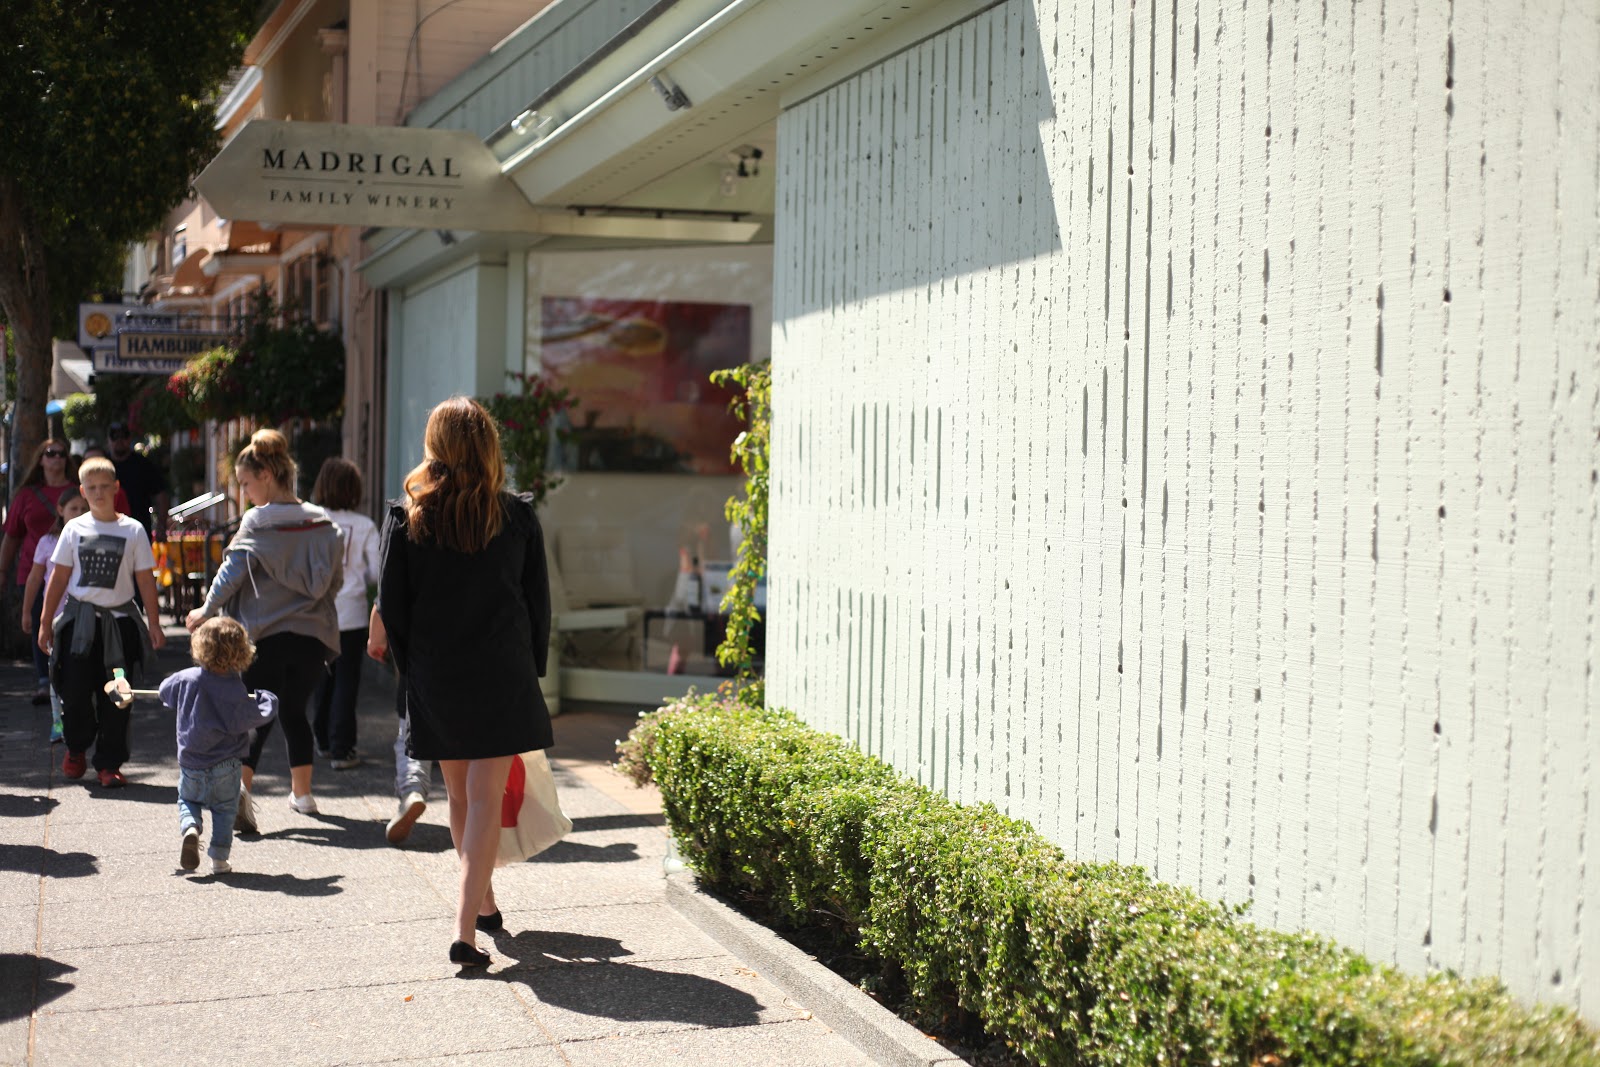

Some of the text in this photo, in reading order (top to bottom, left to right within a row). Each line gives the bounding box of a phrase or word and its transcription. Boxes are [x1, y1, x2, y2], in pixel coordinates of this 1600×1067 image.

[263, 148, 461, 178] MADRIGAL
[270, 189, 454, 209] FAMILY WINERY
